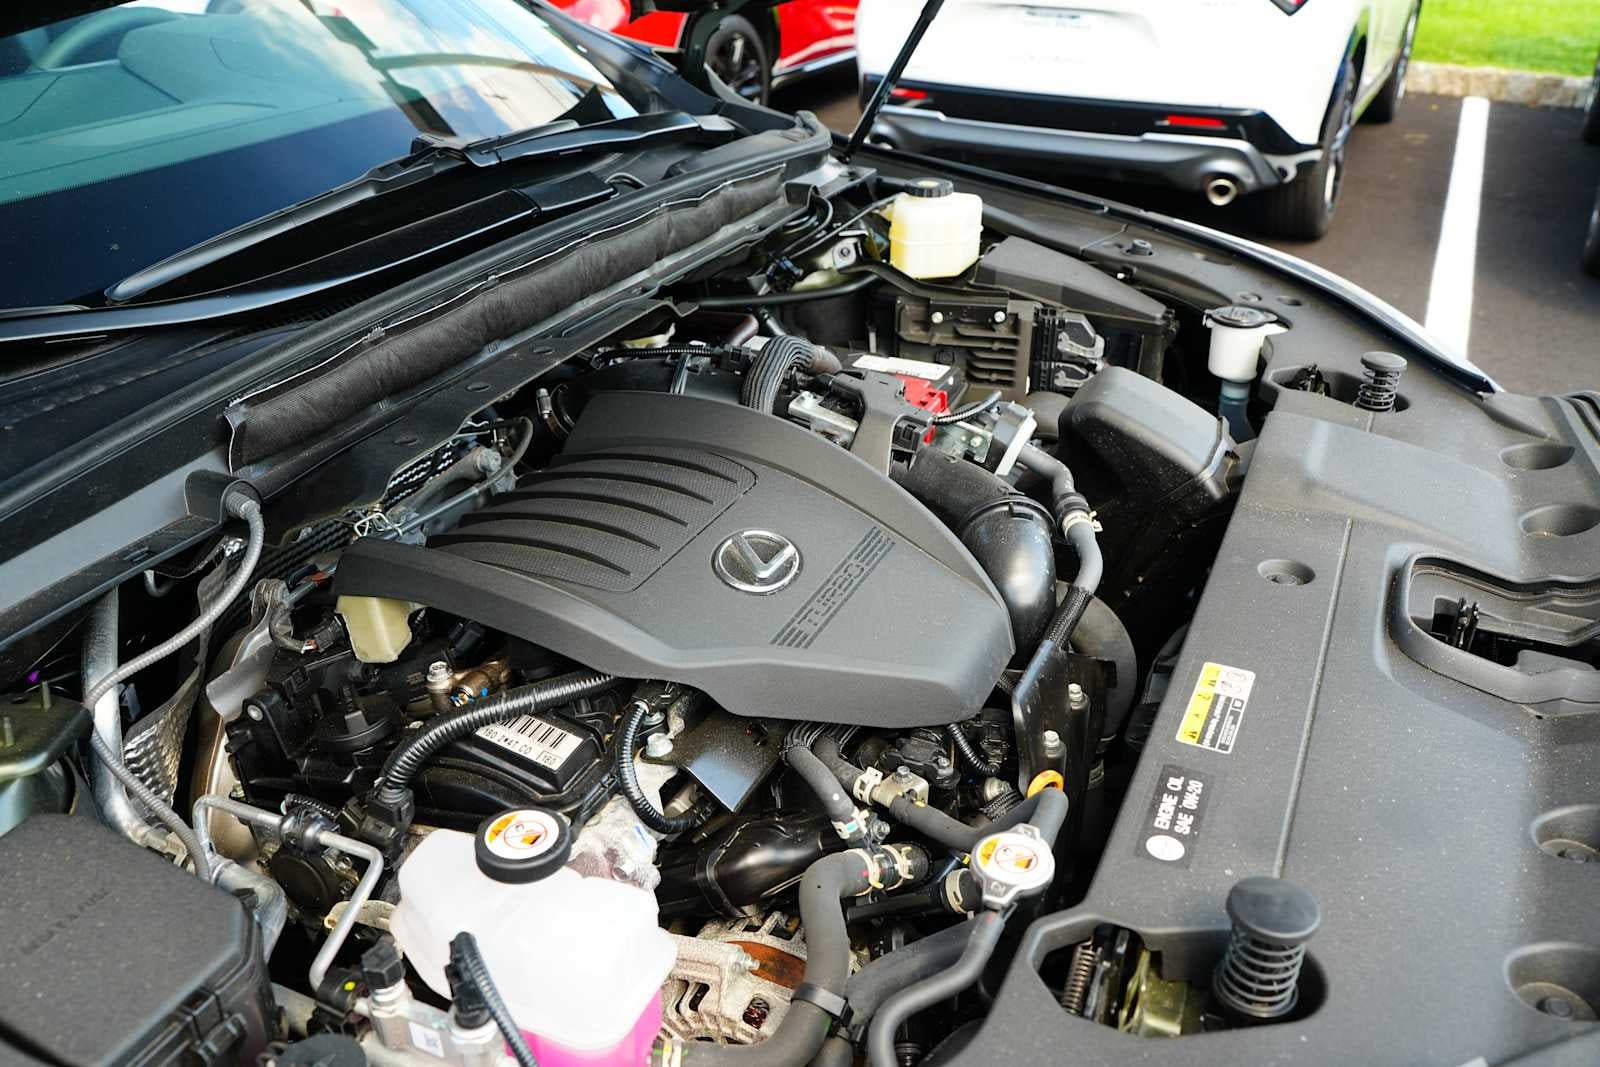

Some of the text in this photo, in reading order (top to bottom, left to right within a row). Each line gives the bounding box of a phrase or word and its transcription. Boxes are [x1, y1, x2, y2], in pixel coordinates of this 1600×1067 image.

[797, 562, 865, 627] TURBO
[1154, 776, 1185, 830] ENGINE OIL
[1174, 812, 1194, 835] SAE
